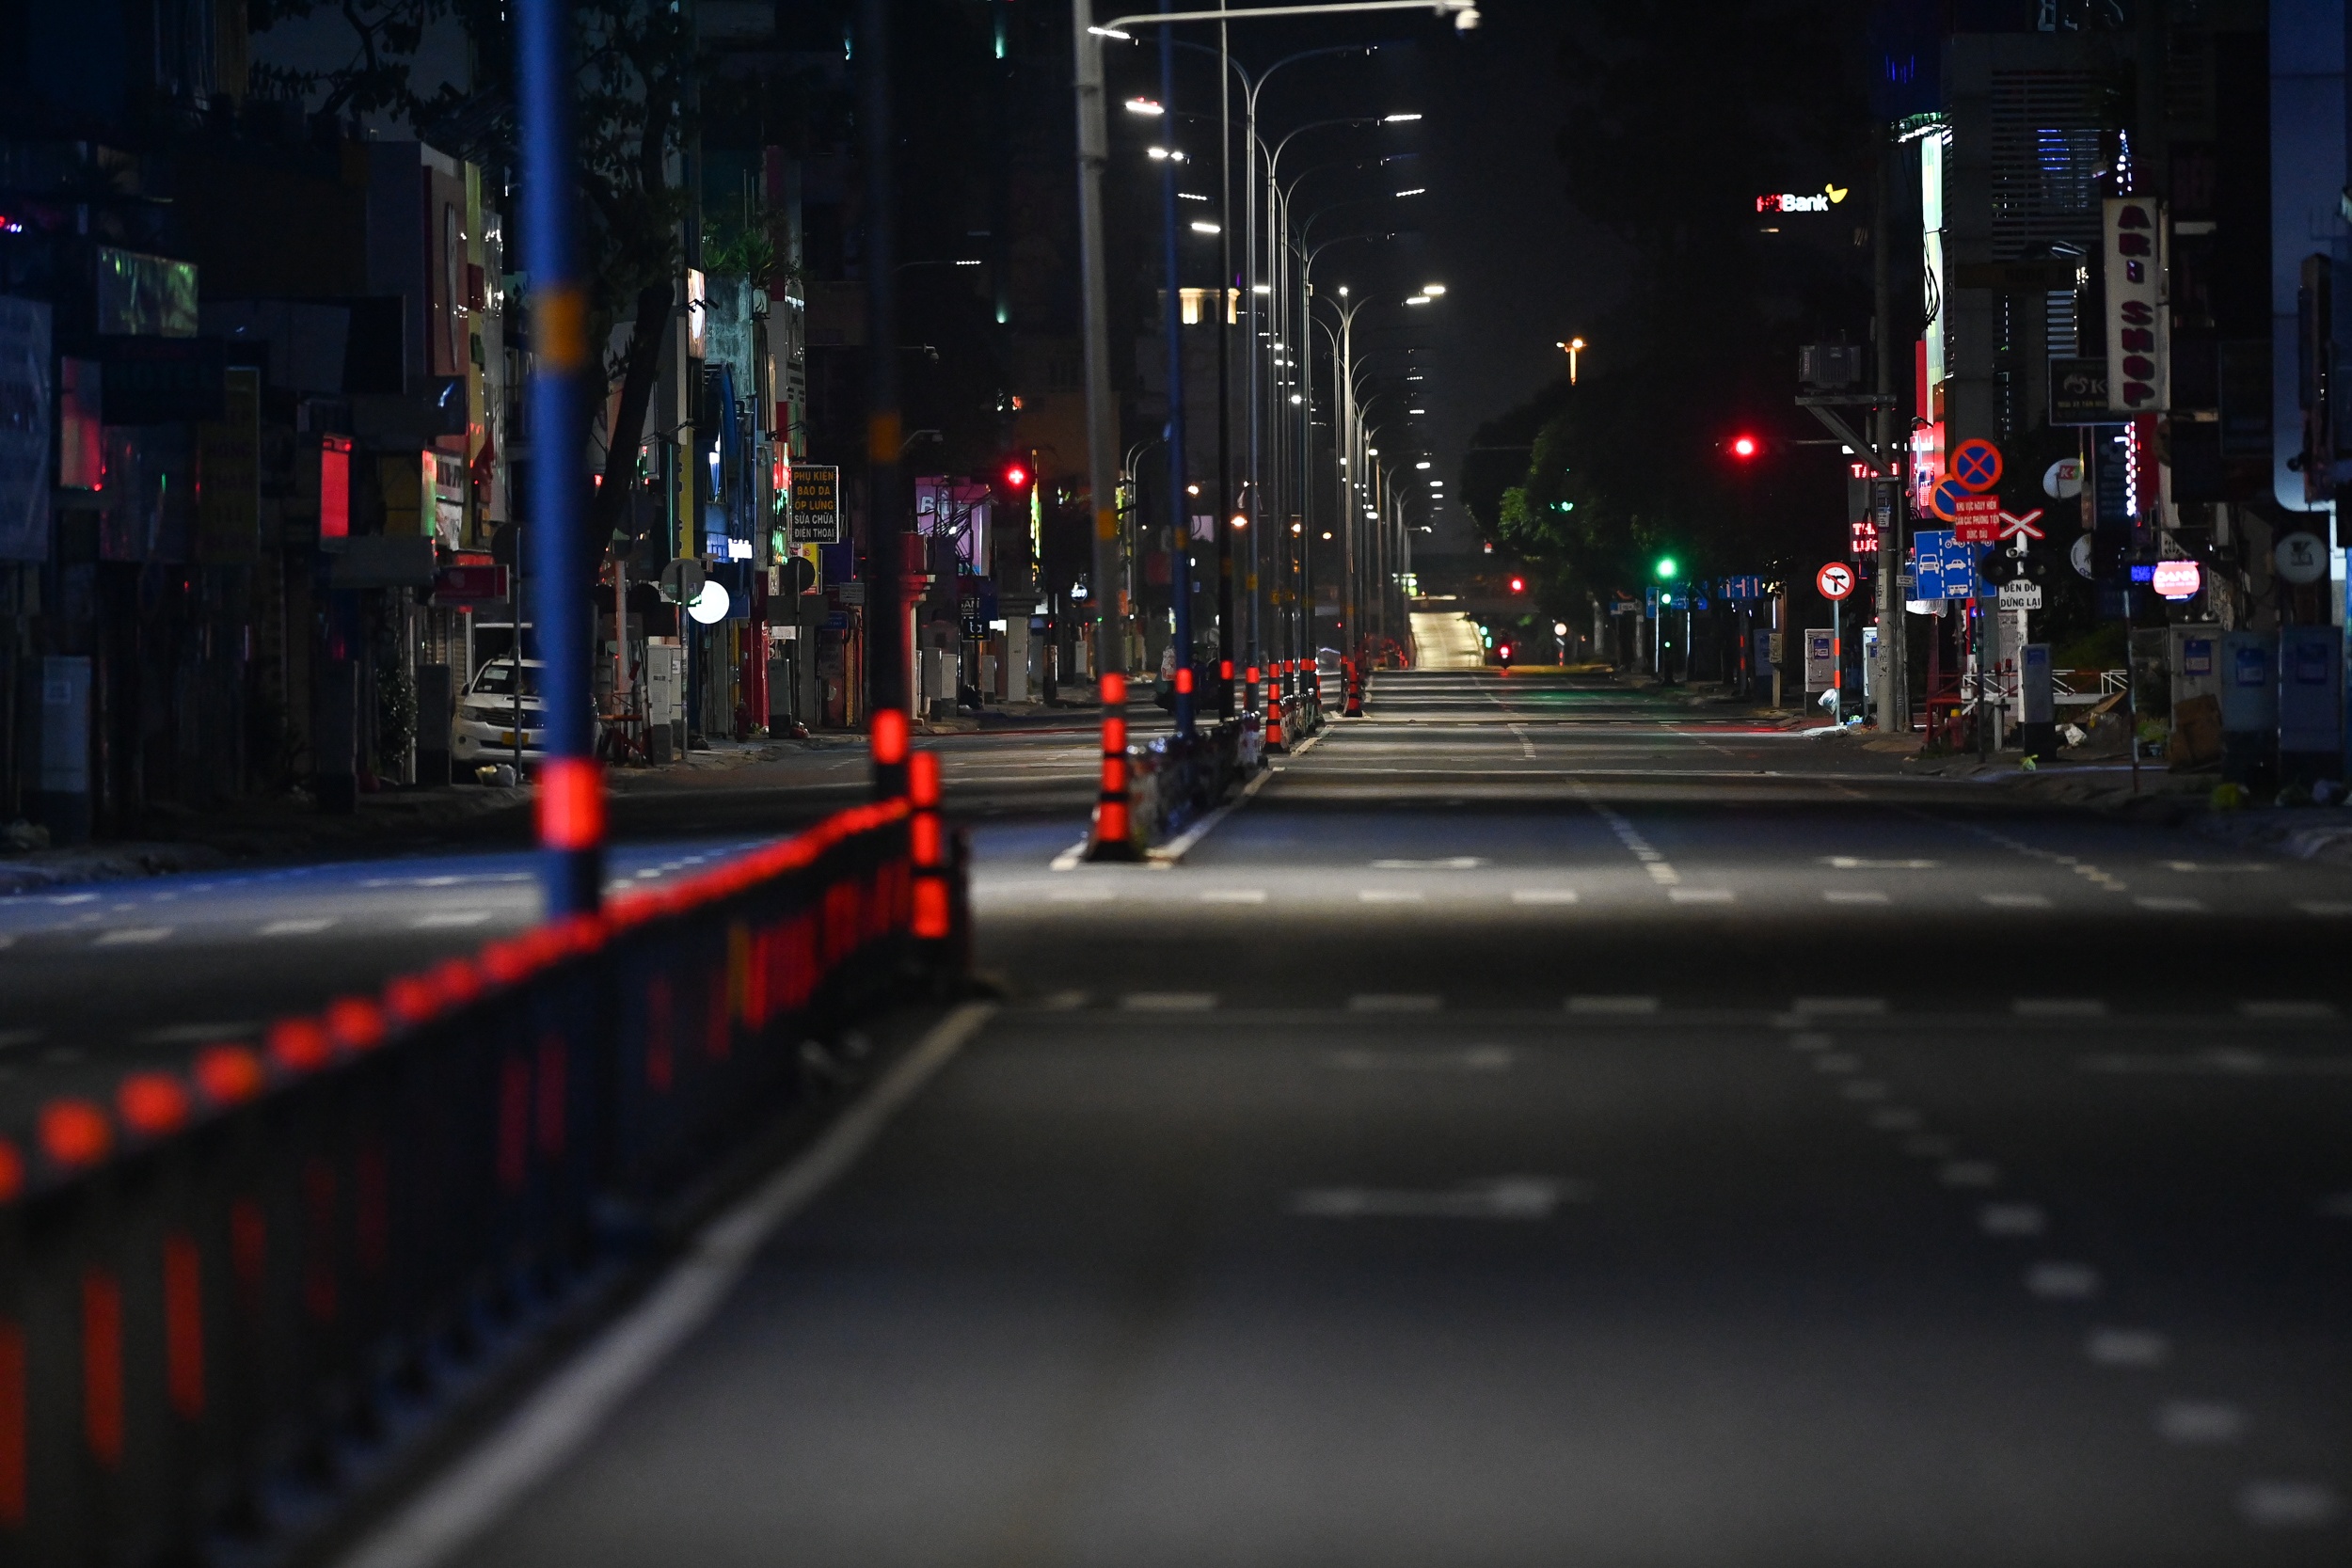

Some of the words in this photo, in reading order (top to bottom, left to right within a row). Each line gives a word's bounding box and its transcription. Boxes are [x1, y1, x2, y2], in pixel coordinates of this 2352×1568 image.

[794, 471, 811, 483] PHỤ
[814, 470, 834, 483] KIỆN
[797, 486, 816, 496] BAO
[818, 486, 831, 496] DA
[794, 498, 807, 510] ỐP
[809, 499, 834, 510] LƯNG
[794, 512, 810, 524] SỬA
[812, 512, 834, 524] CHỮA
[794, 527, 812, 540] ĐIỆN
[813, 528, 834, 541] THOẠI
[2000, 596, 2025, 608] DỪNG
[2026, 597, 2041, 609] LẠI
